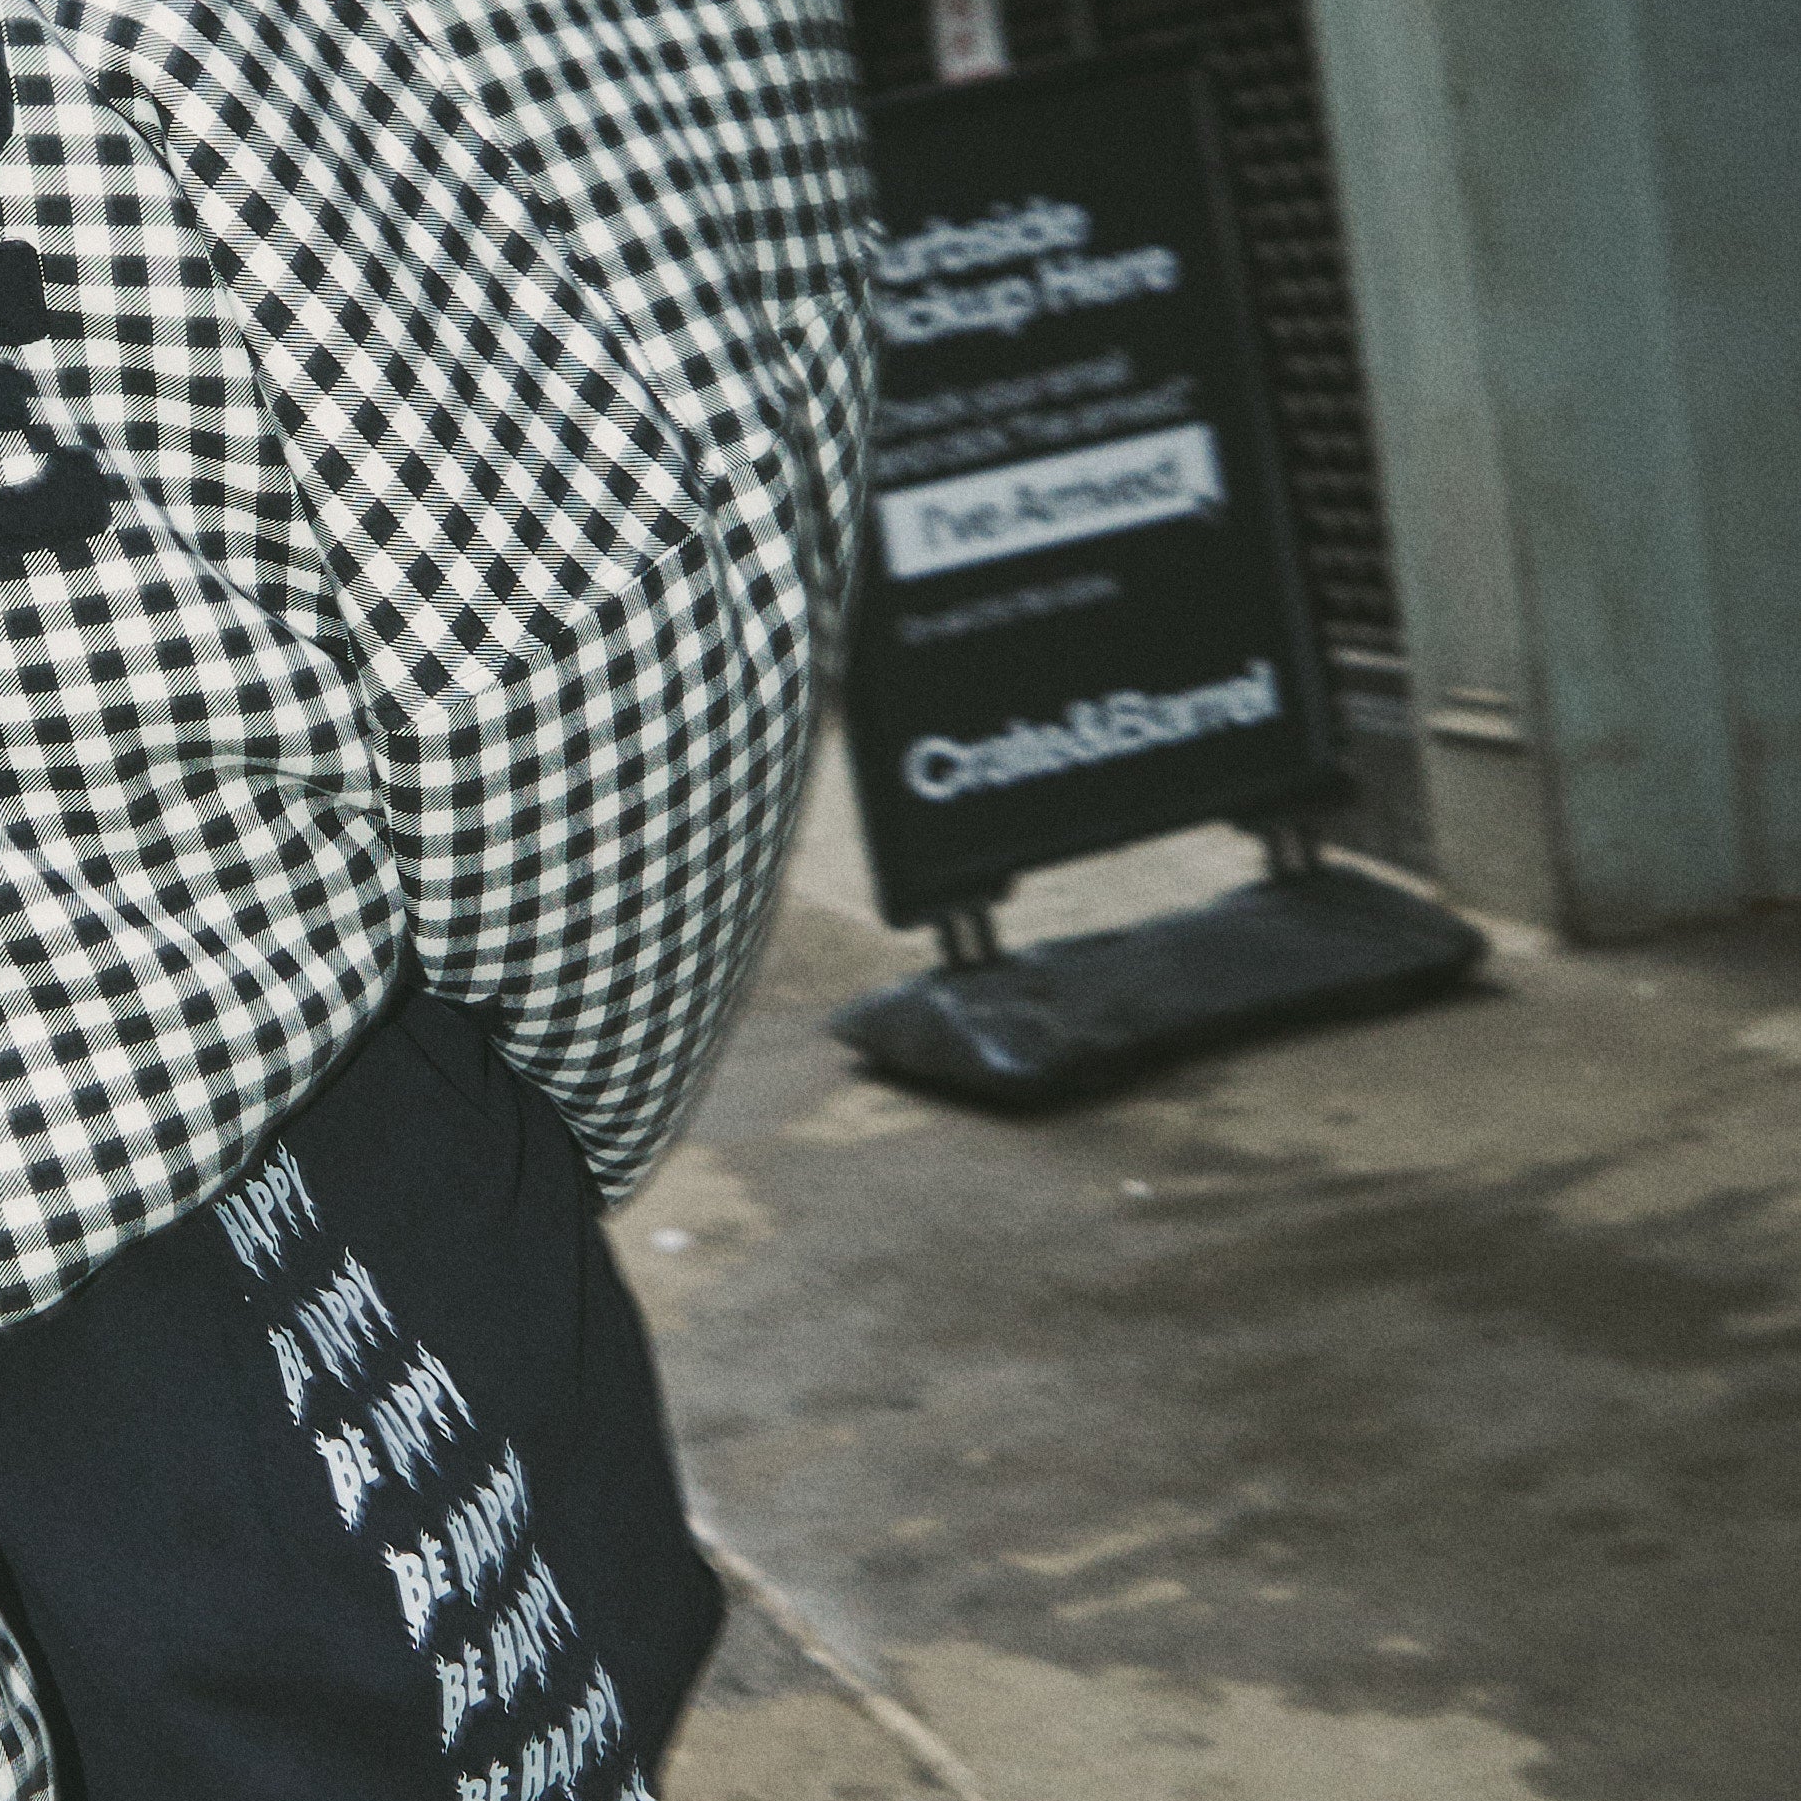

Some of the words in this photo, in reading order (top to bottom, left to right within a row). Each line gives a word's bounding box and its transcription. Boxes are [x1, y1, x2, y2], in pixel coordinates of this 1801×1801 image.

[212, 1138, 320, 1282] HAPPY
[266, 1323, 314, 1428] BE
[295, 1245, 399, 1392] HAPPY
[312, 1418, 380, 1532] BE
[366, 1339, 479, 1495] HAPPY
[382, 1527, 452, 1651] BE
[446, 1436, 529, 1608] HAPPY
[435, 1636, 487, 1755] BE
[490, 1542, 582, 1715] HAPPY
